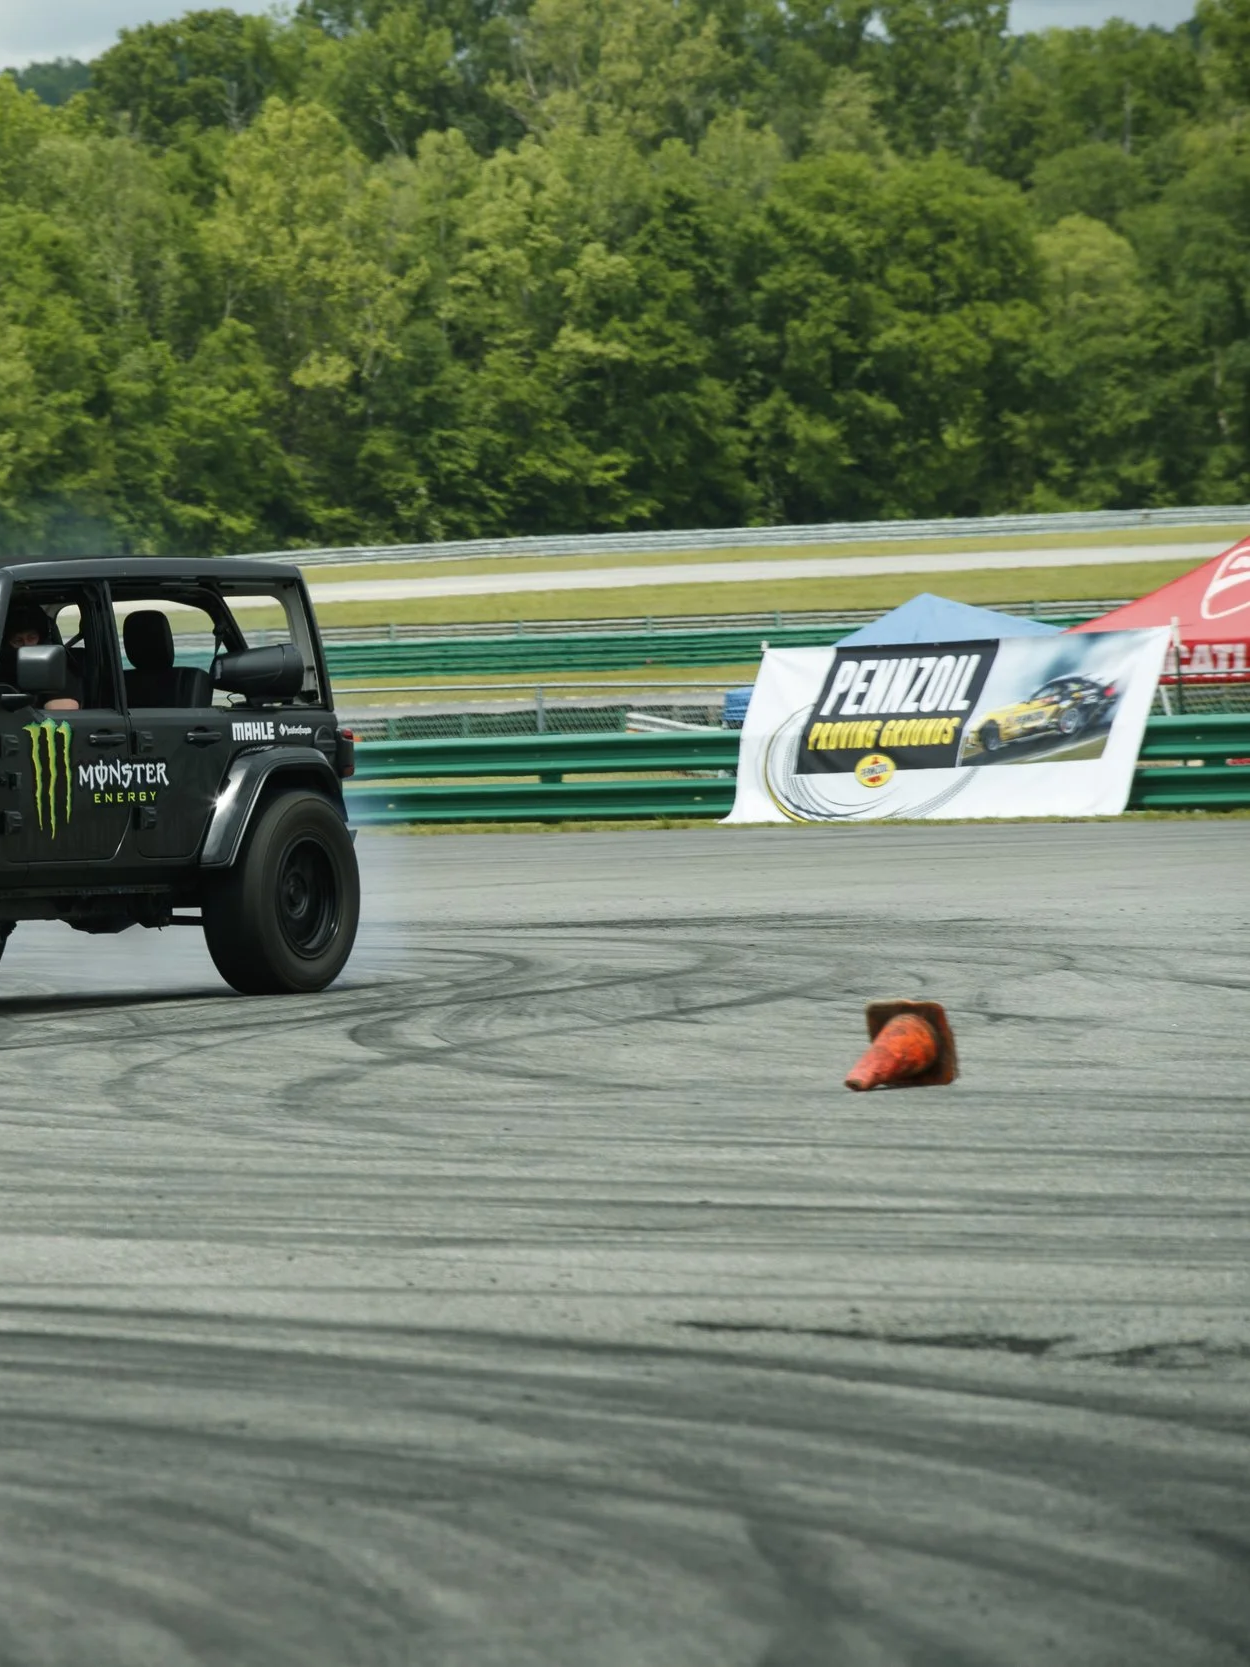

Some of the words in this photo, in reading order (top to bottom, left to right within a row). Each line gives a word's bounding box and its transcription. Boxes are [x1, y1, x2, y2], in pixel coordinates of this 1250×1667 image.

[1164, 643, 1247, 677] CATI
[818, 653, 982, 717] PENNZOIL
[231, 721, 276, 741] MAHLE
[807, 719, 884, 751] PROVING
[878, 716, 963, 748] GROUNDS
[78, 758, 170, 791] MONSTER
[94, 791, 157, 804] ENERGY
